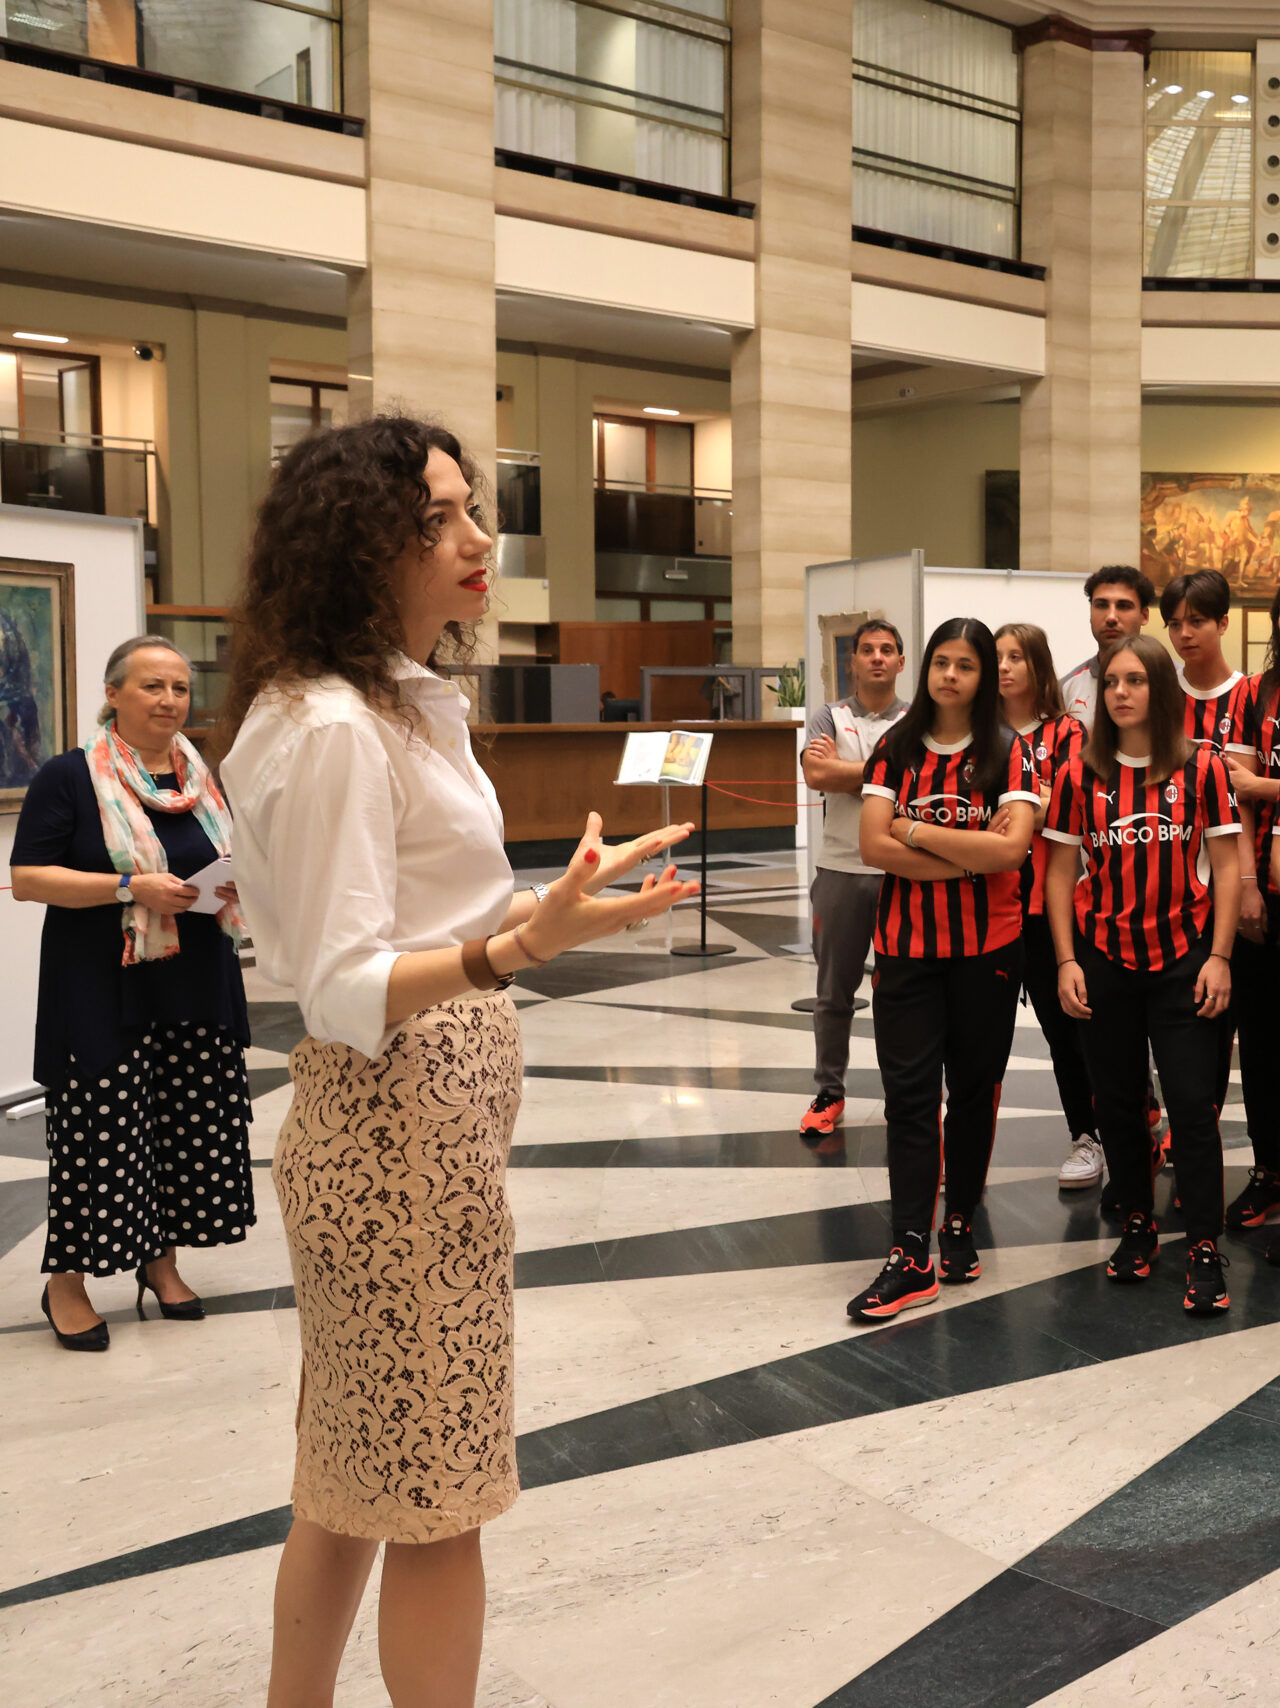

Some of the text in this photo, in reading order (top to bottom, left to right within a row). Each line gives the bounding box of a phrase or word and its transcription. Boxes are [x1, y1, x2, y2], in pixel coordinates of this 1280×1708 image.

[955, 805, 992, 822] BPM
[1090, 824, 1193, 848] BANCO BPM
